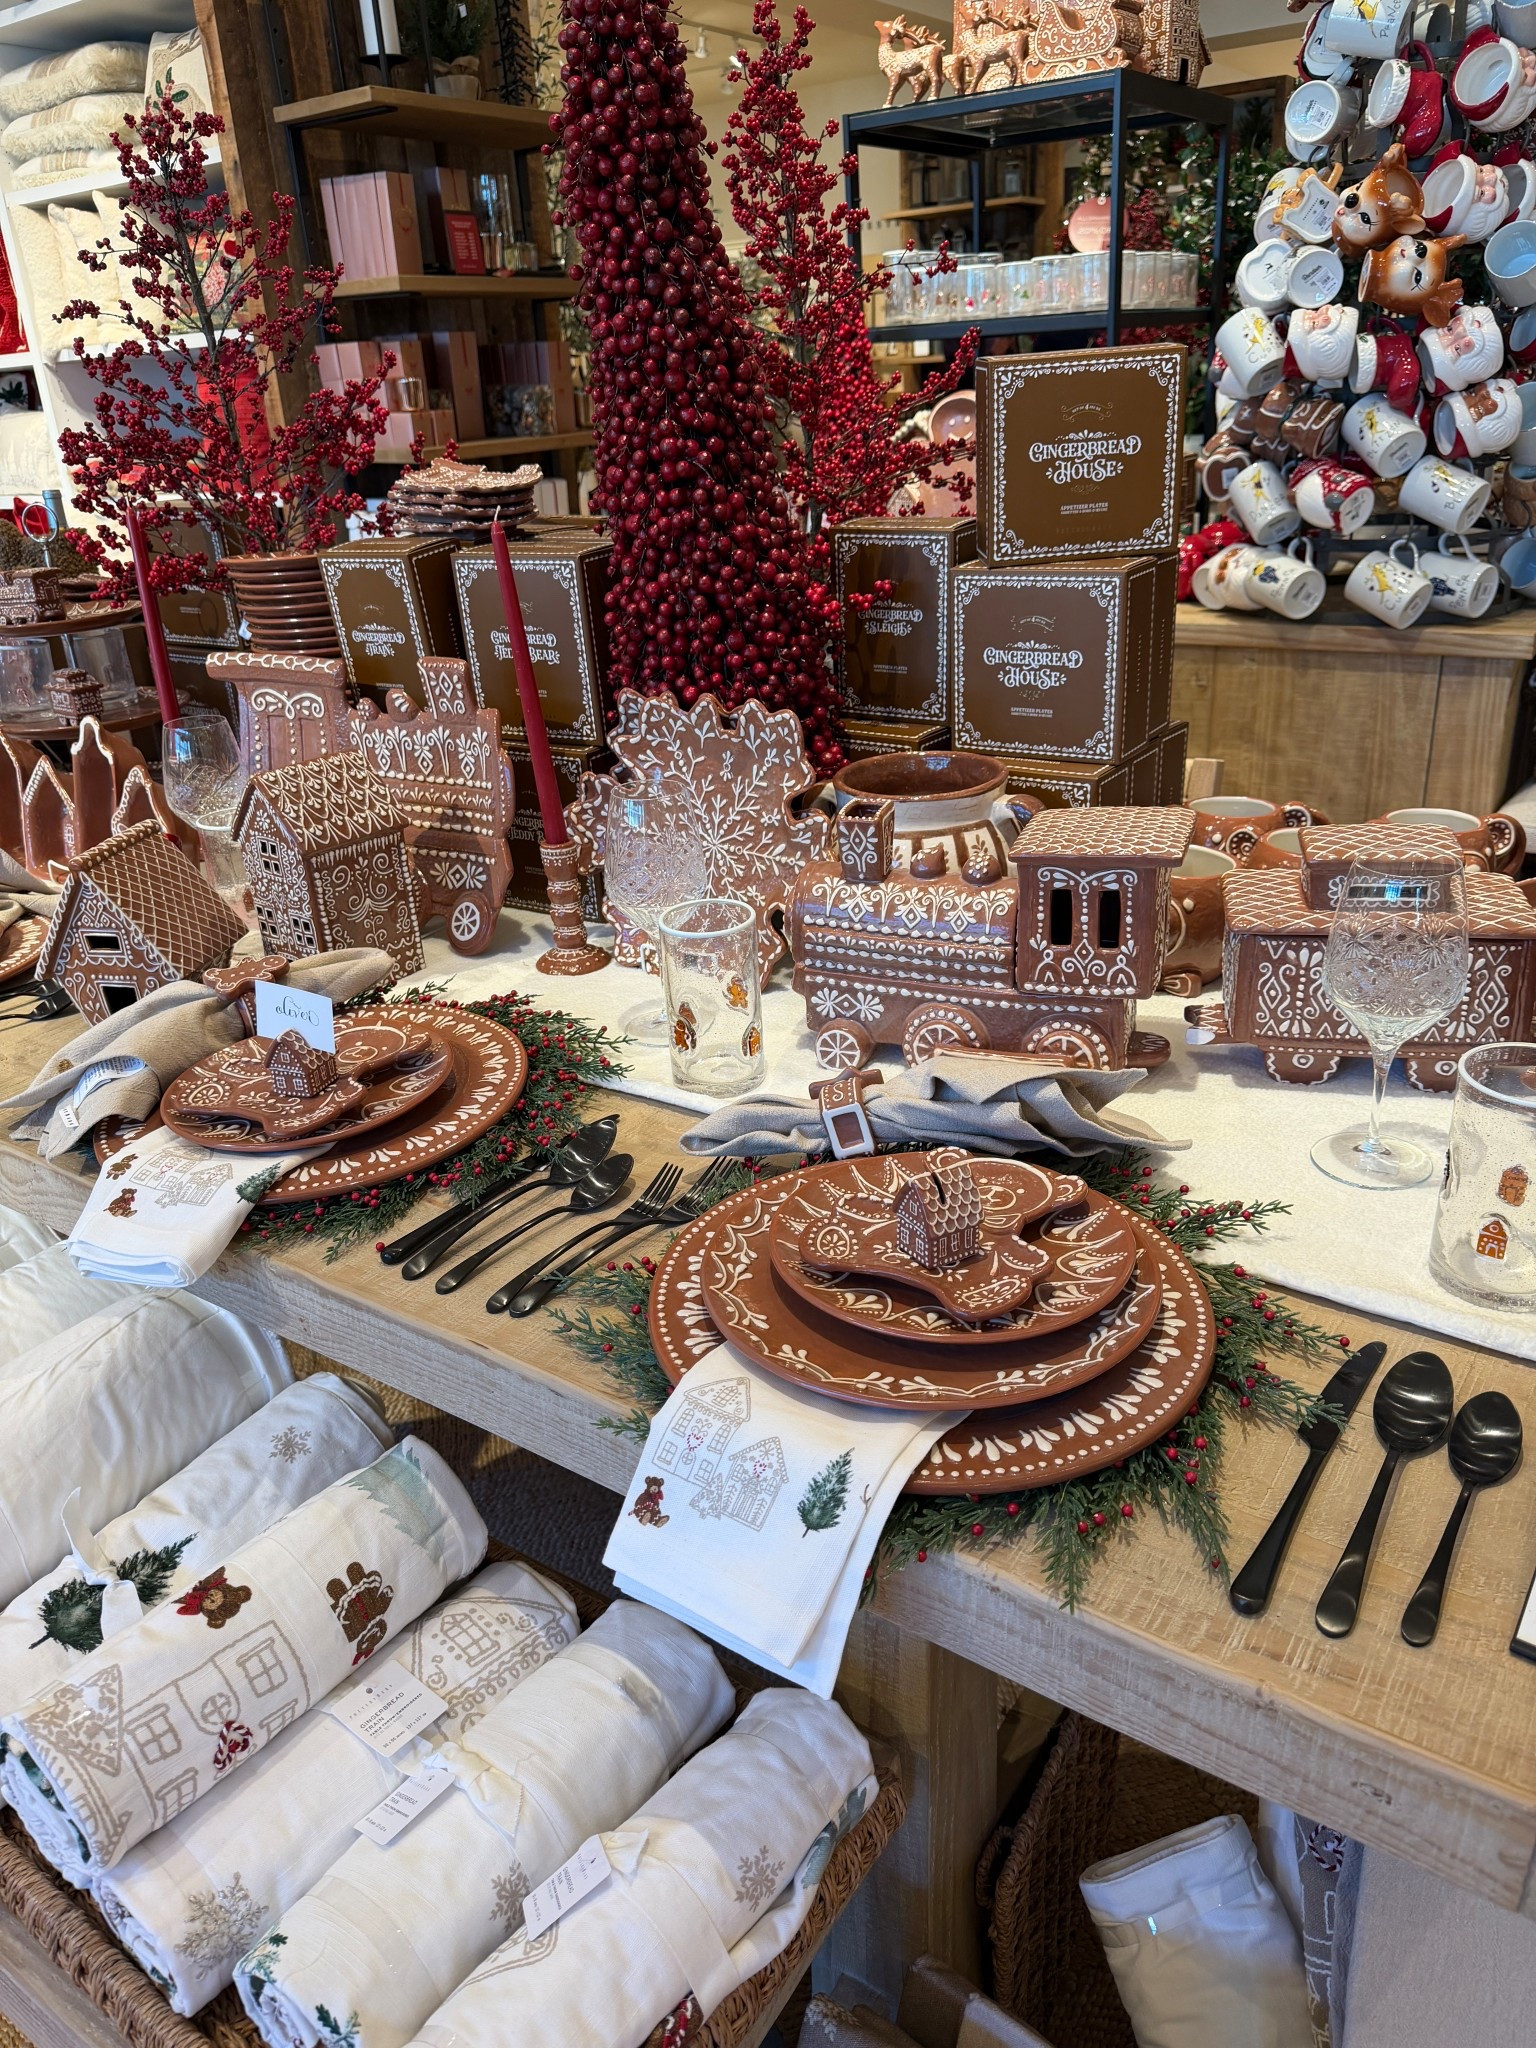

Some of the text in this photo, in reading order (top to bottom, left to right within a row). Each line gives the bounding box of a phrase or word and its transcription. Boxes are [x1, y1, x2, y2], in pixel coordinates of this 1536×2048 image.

[1028, 434, 1142, 463] GINGERBREAD
[1053, 458, 1118, 484] HOUSE
[858, 608, 923, 624] GINGERBREAD
[352, 630, 405, 644] GINGERBREAD
[867, 620, 907, 637] SLEIGH
[366, 643, 391, 657] TRAIN
[529, 647, 560, 665] BEAR
[983, 646, 1083, 669] GINGERBREAD
[1004, 666, 1060, 689] HOUSE
[510, 827, 535, 841] TEDDY
[275, 995, 320, 1026] oliver
[360, 1692, 404, 1729] GINGERBREAD
[364, 1716, 385, 1732] TRAIN
